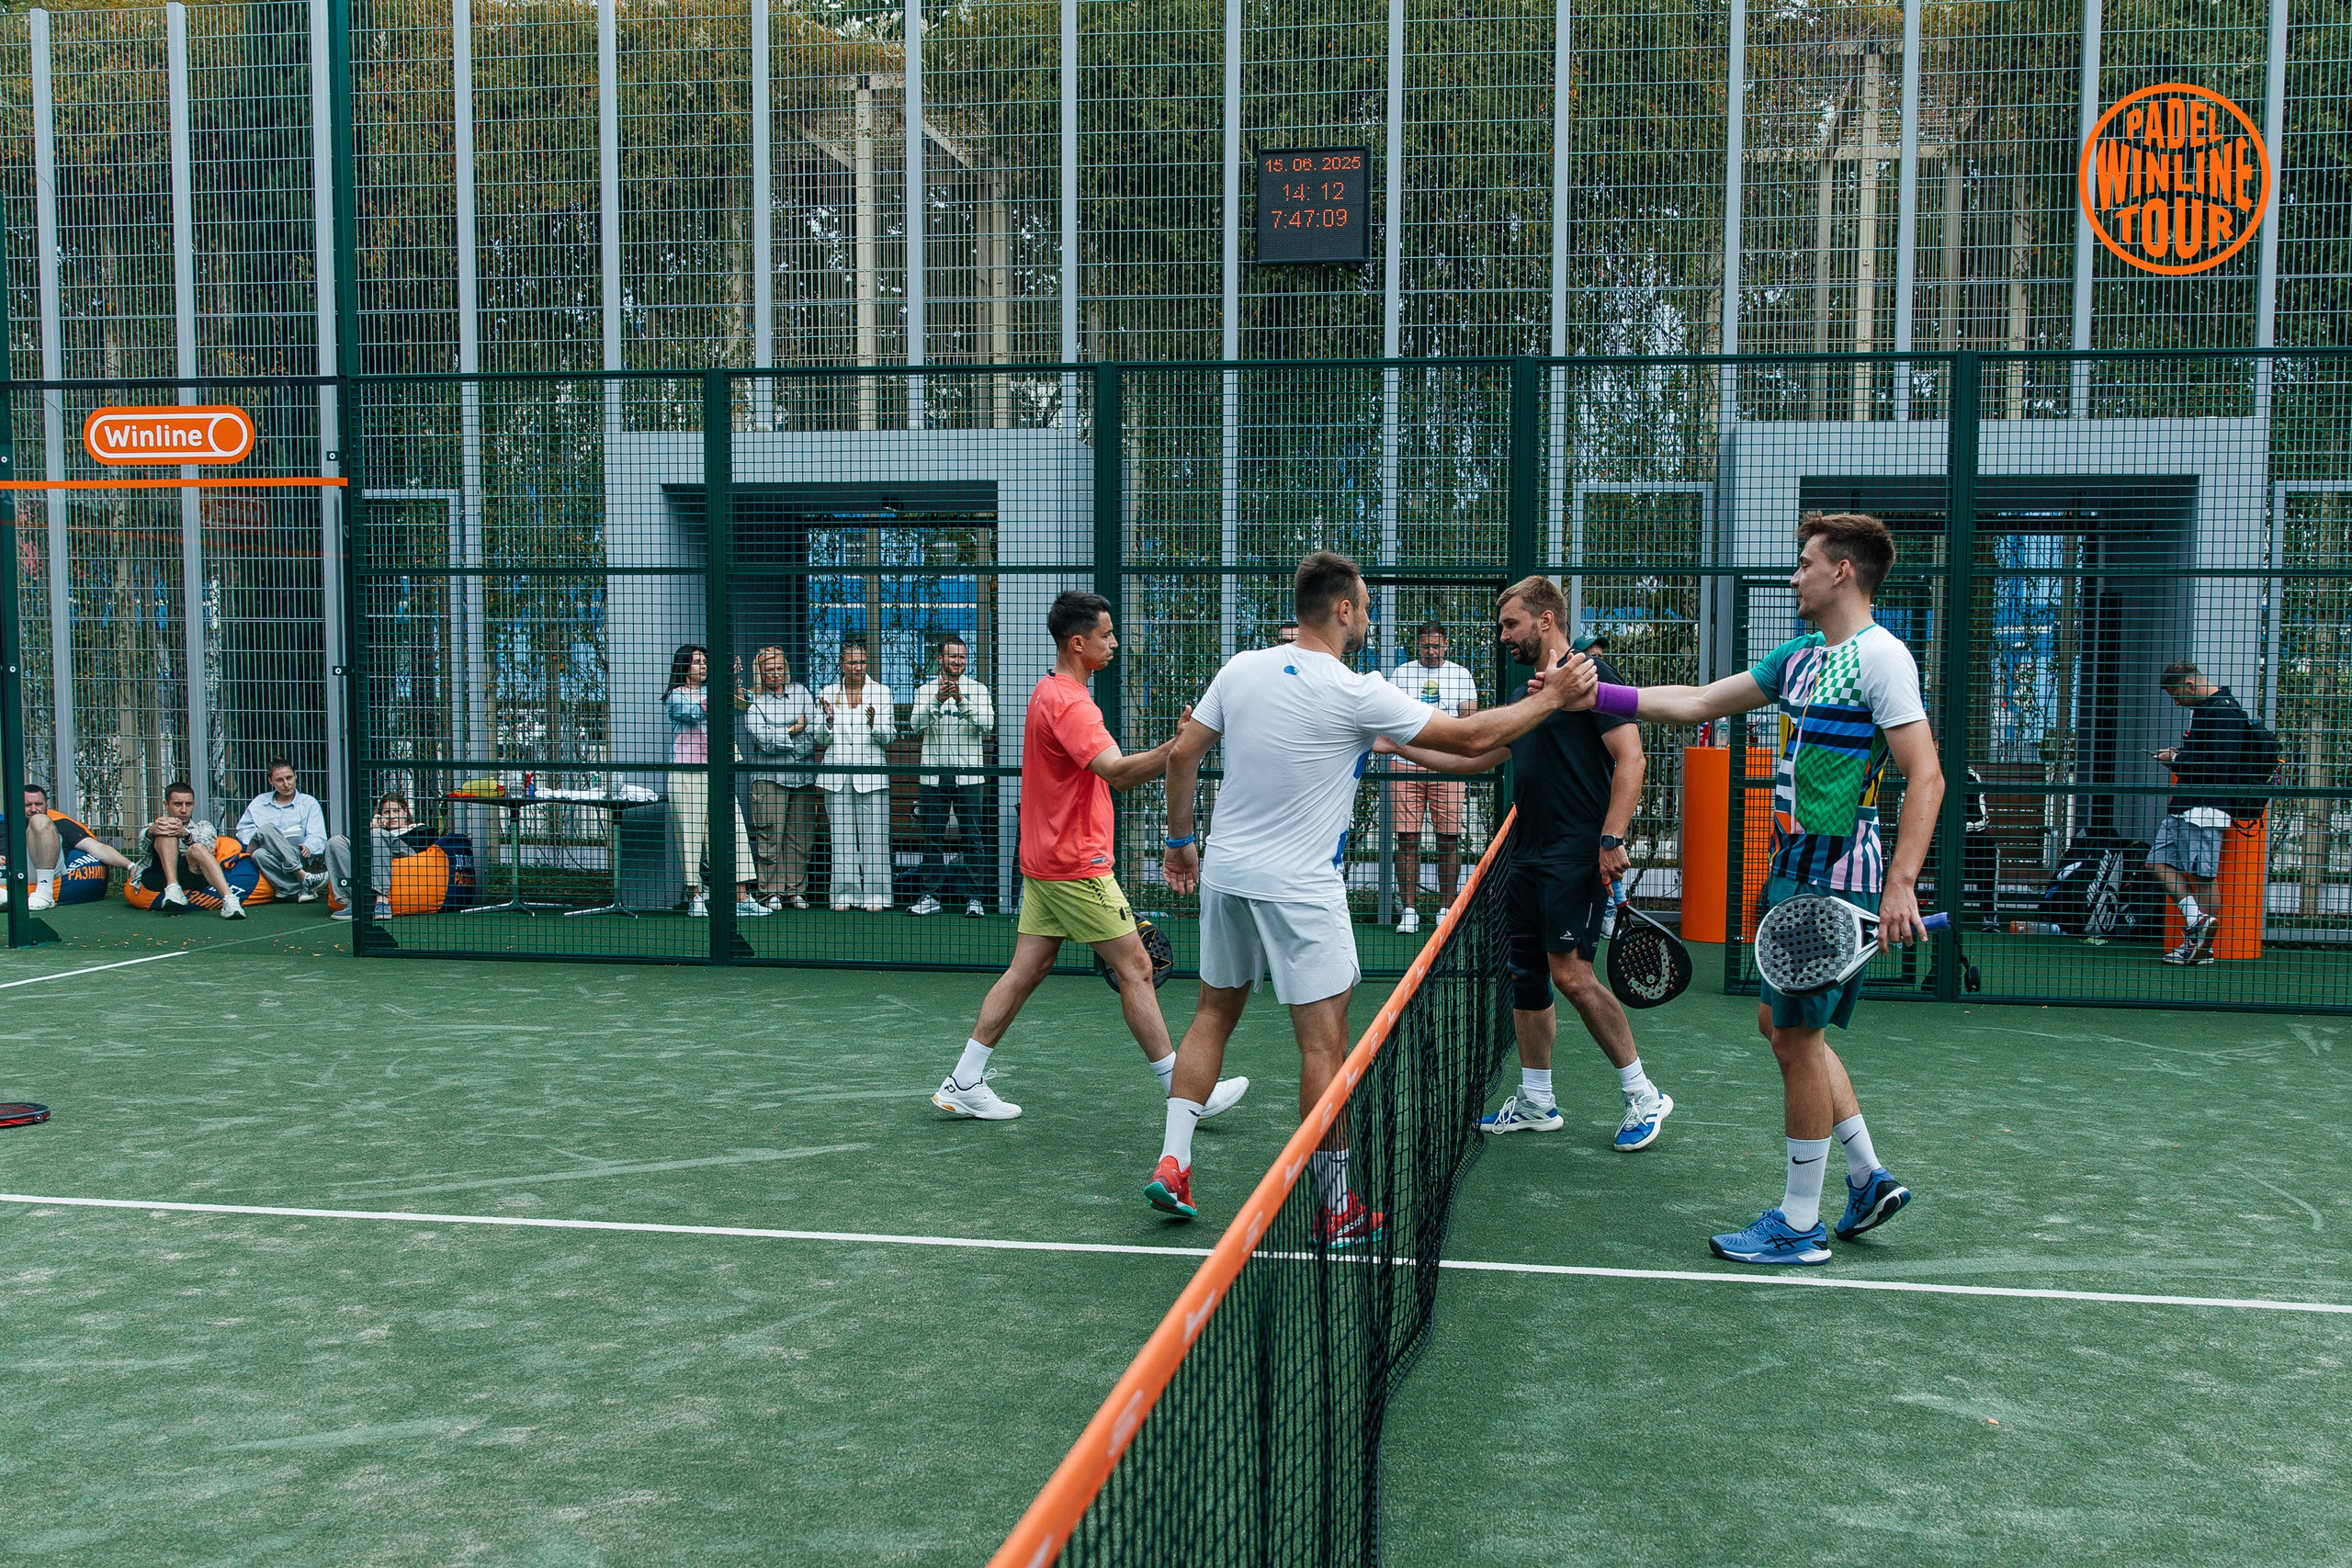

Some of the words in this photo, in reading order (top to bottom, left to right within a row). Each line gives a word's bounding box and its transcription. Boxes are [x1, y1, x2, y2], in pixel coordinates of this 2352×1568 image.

[1271, 208, 1348, 229] 7:47:09
[103, 424, 203, 448] Winline
[1838, 910, 1848, 961] starvie
